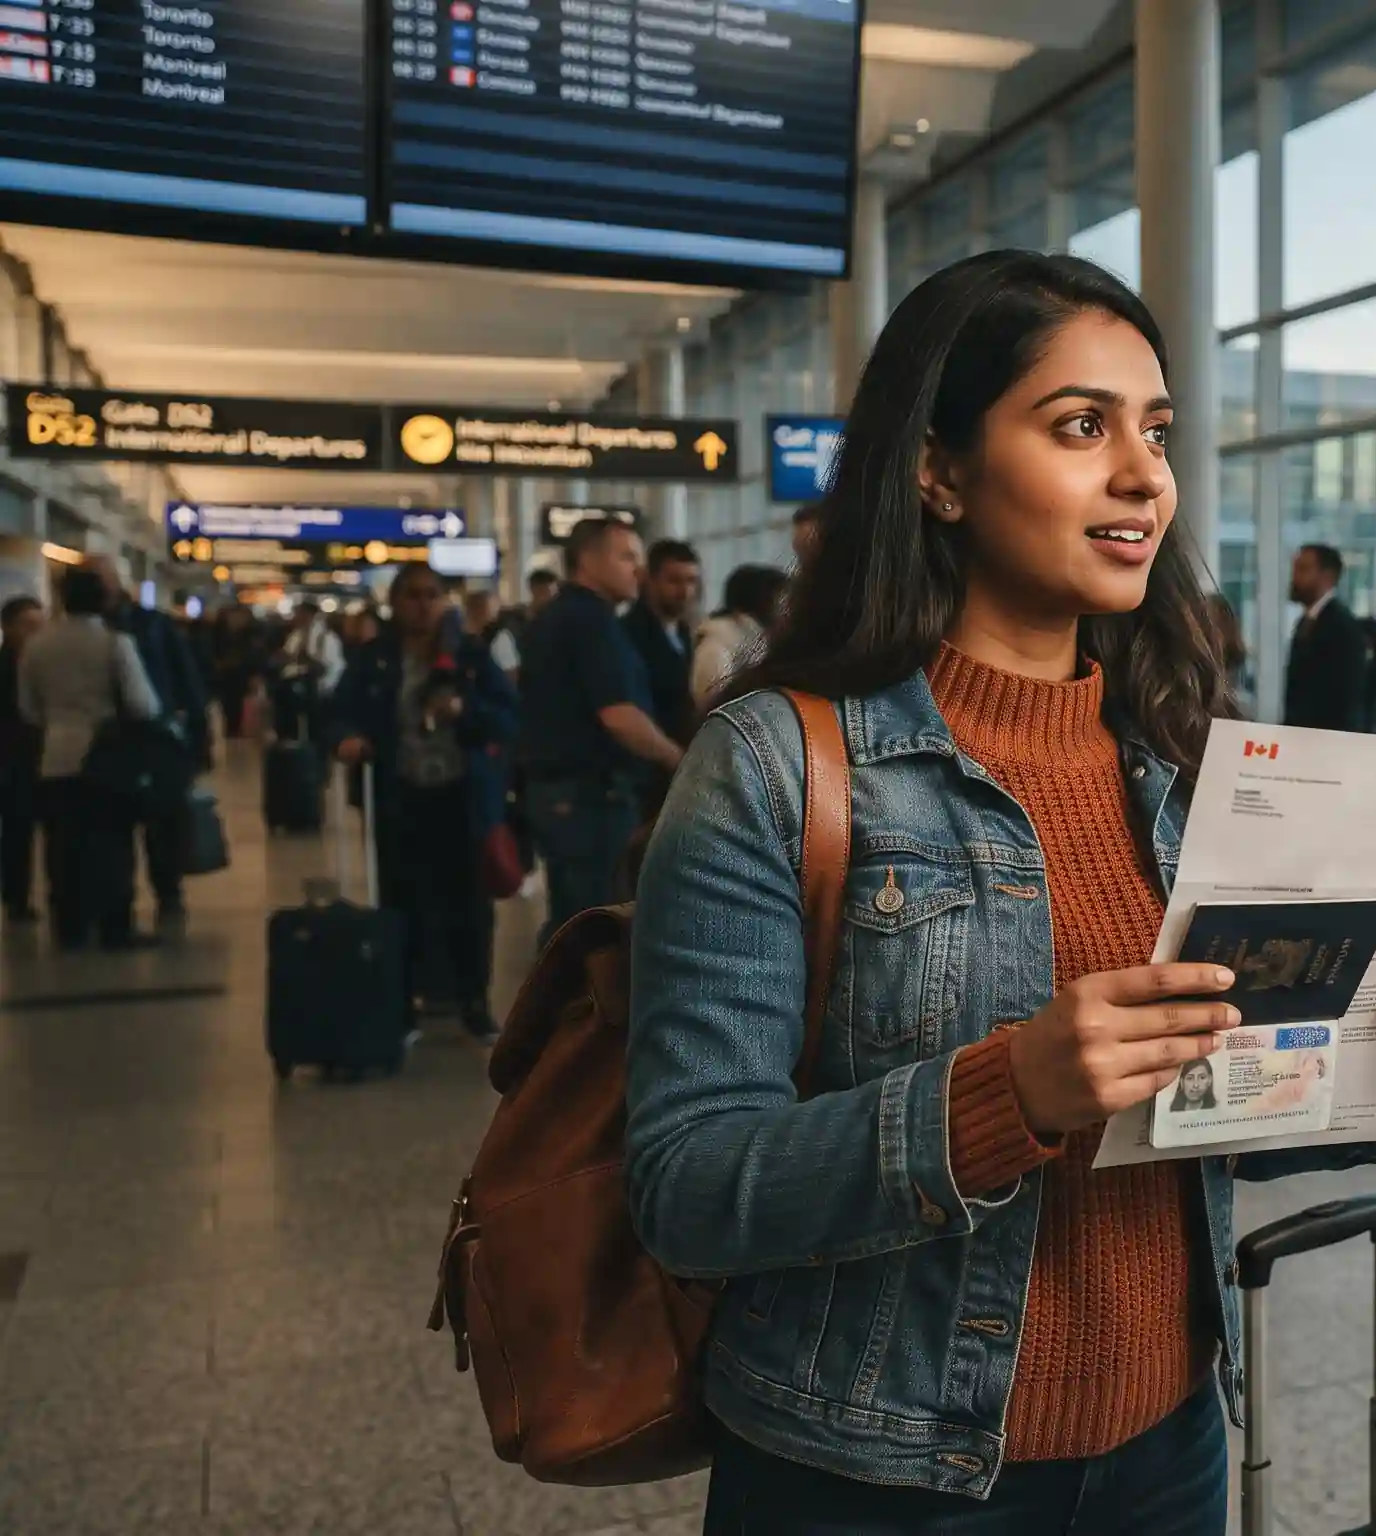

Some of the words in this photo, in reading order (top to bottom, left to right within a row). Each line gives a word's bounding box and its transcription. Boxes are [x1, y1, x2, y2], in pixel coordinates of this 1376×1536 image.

[143, 3, 214, 28] Toronto
[142, 25, 215, 53] Toronto
[143, 53, 226, 80] Montreal
[142, 78, 225, 104] Montreal
